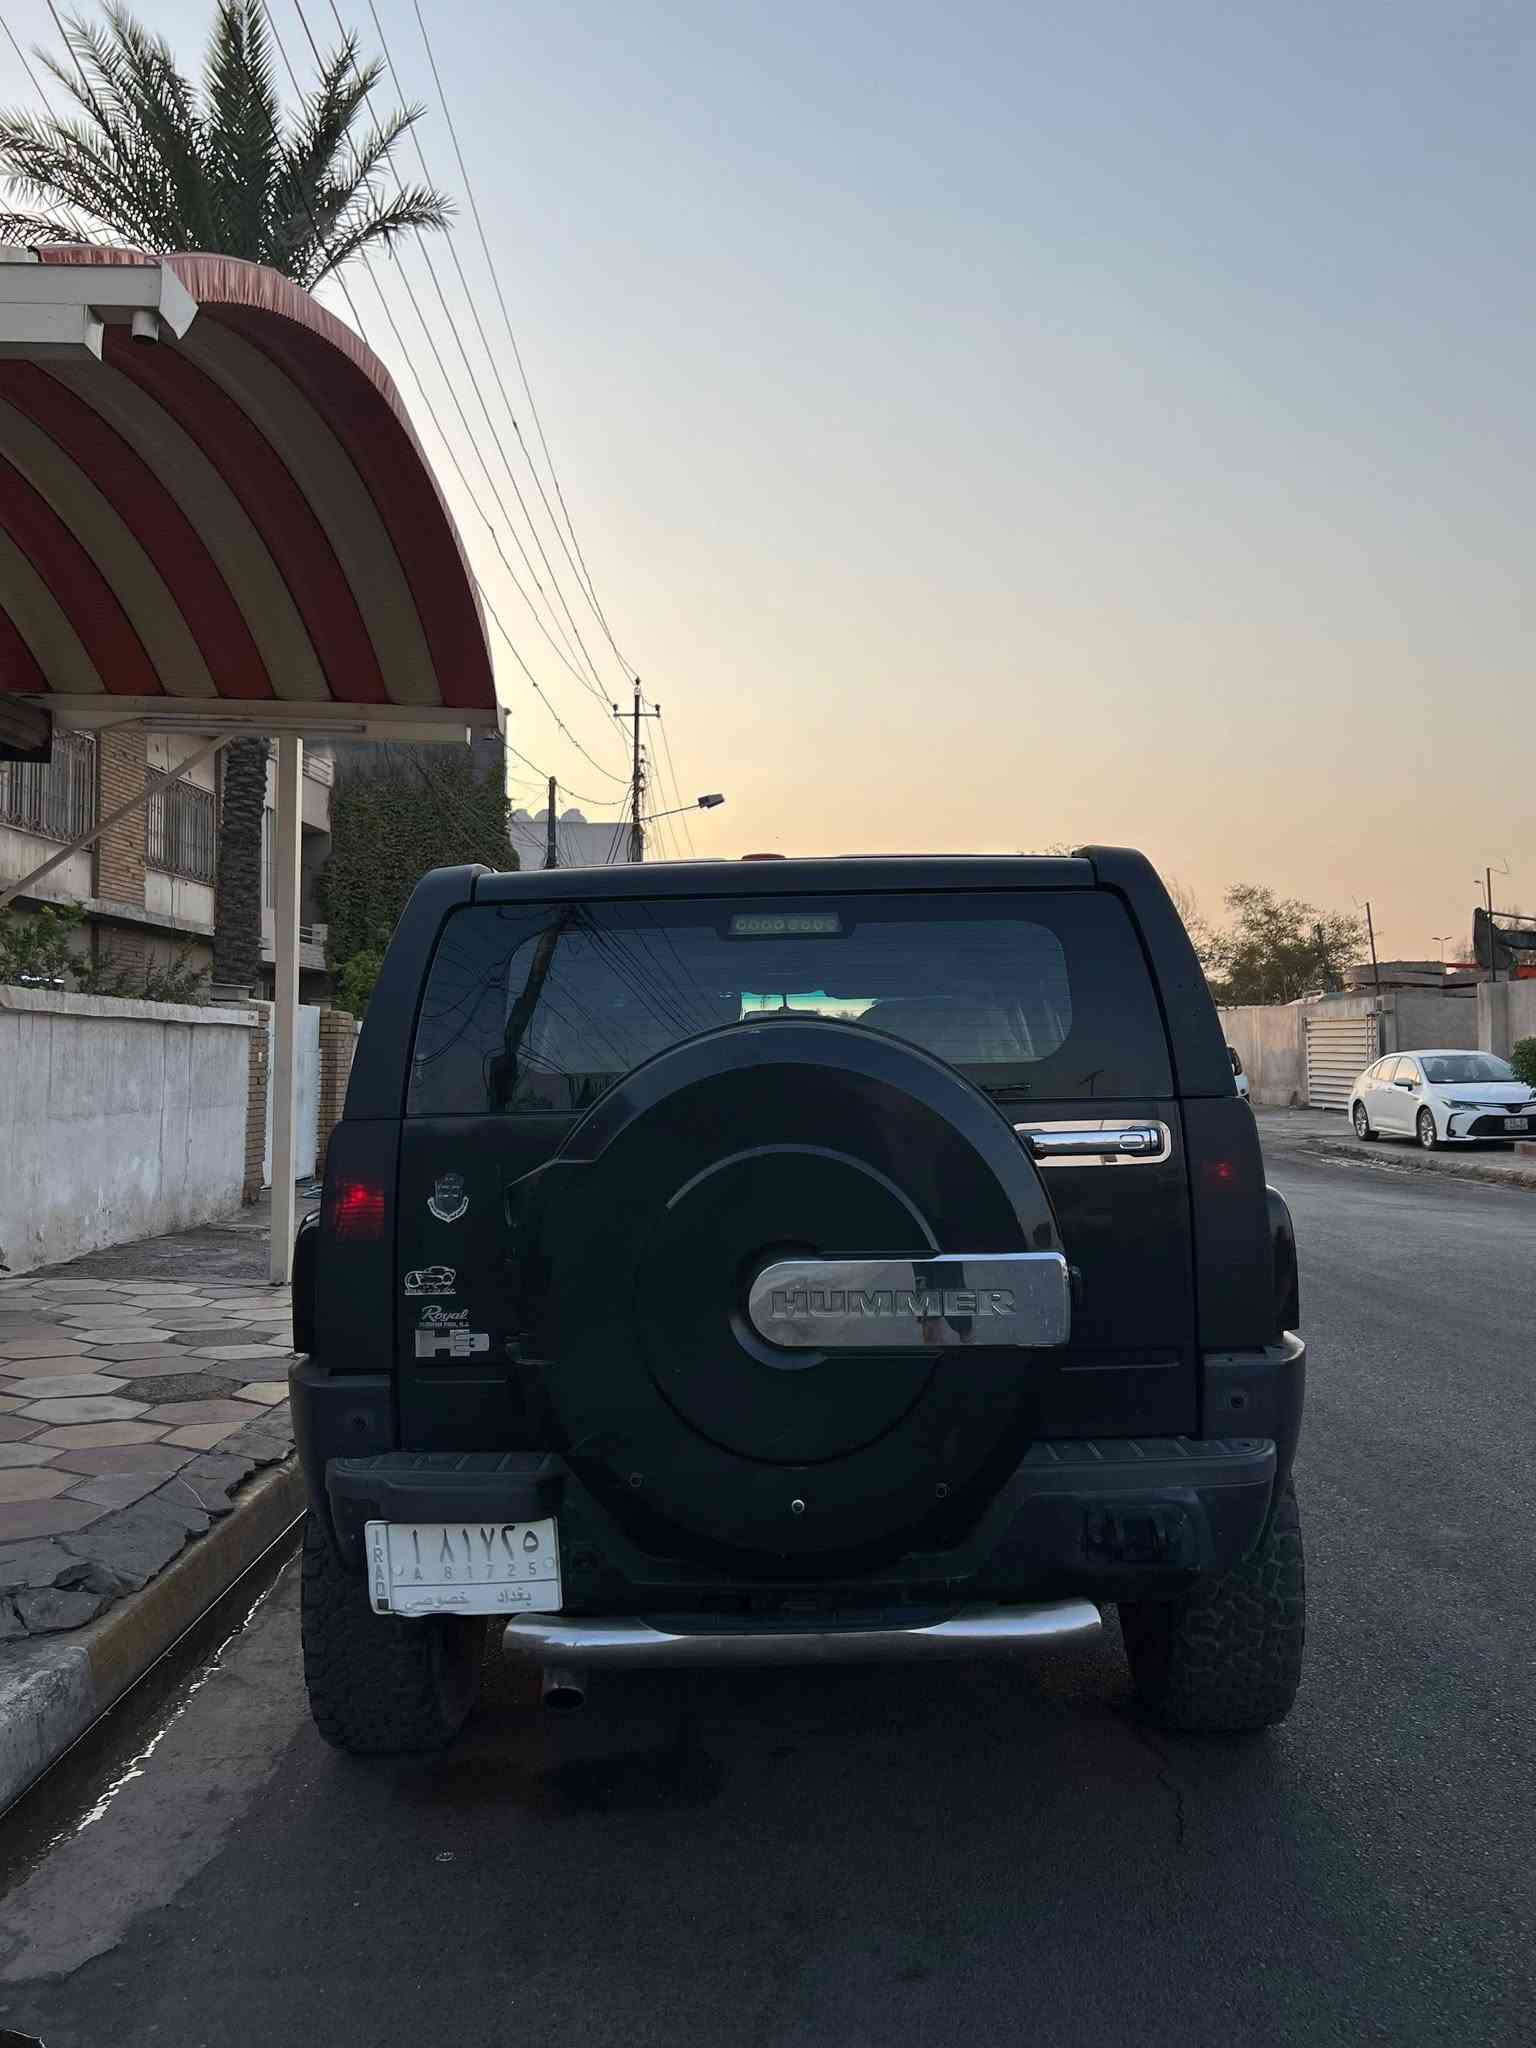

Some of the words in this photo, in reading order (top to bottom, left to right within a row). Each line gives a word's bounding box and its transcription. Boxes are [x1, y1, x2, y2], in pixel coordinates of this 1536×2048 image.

[421, 1304, 470, 1322] Royal
[770, 1288, 1017, 1319] HUMMER
[373, 1530, 386, 1597] IRAQ
[496, 1586, 533, 1607] بغداد
